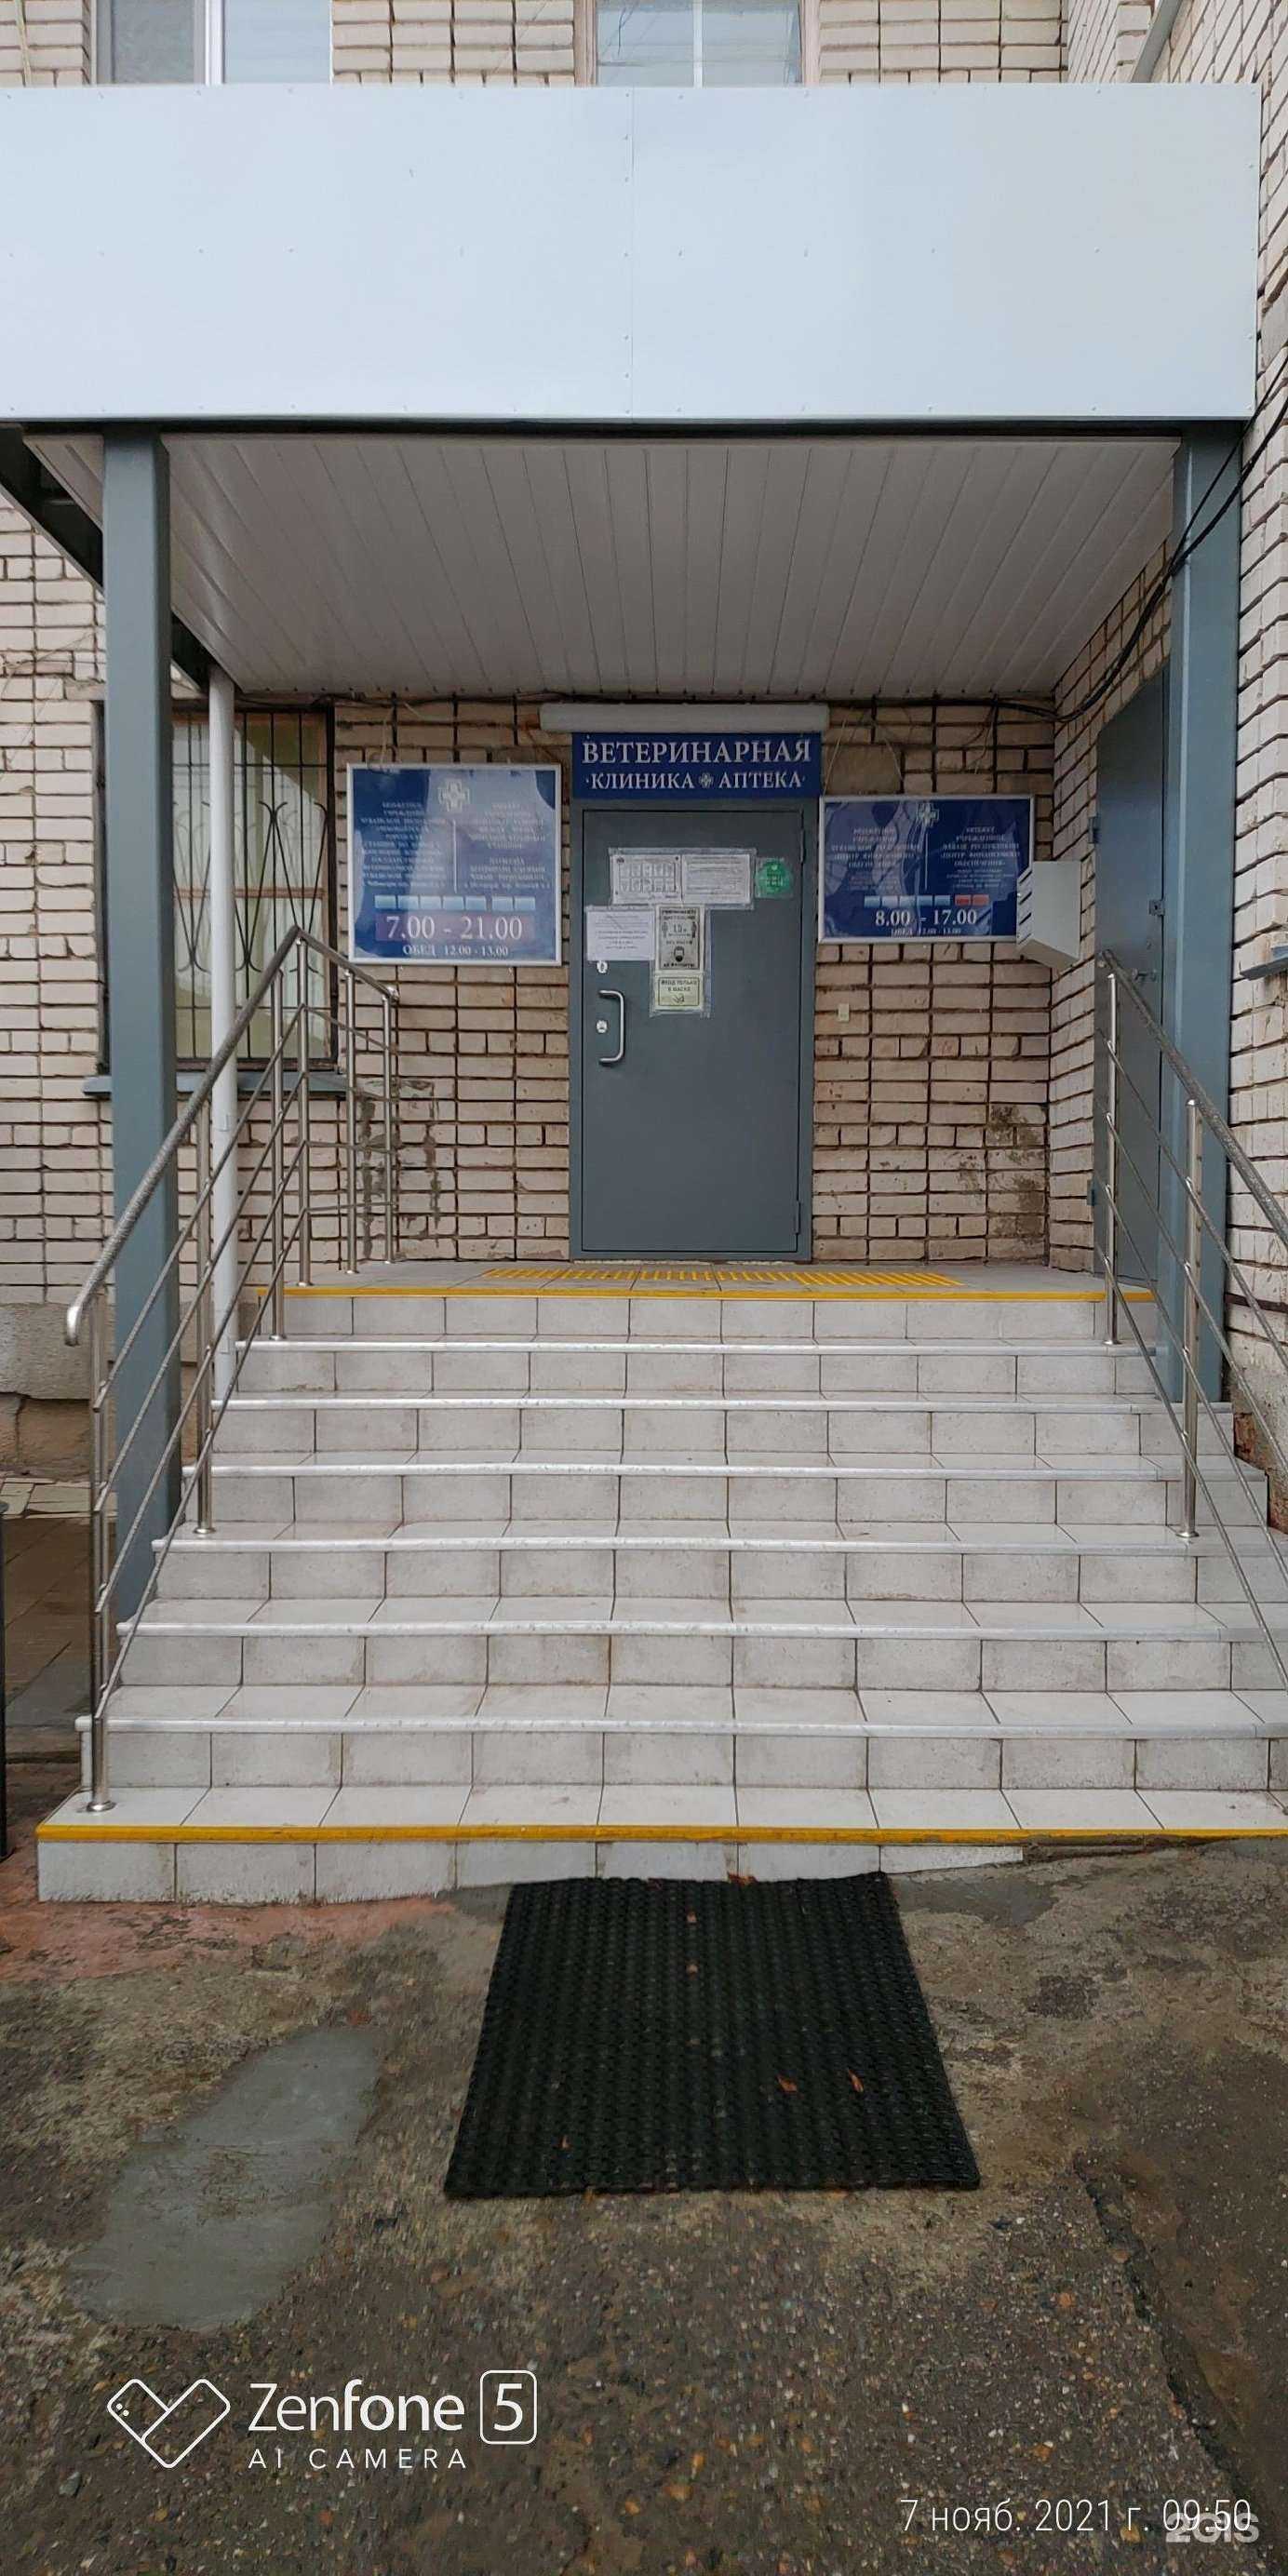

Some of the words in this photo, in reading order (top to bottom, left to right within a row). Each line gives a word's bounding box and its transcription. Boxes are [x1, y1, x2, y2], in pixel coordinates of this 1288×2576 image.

[582, 739, 812, 764] ВЕТЕРИНАРНАЯ
[591, 772, 696, 790] КЛИНИКА
[718, 771, 802, 789] АПТЕКА
[875, 908, 911, 927] 8.00
[932, 908, 977, 926] 17.00
[385, 915, 436, 940] 7.00
[460, 915, 523, 941] 21.00
[402, 944, 436, 957] ОБЕД
